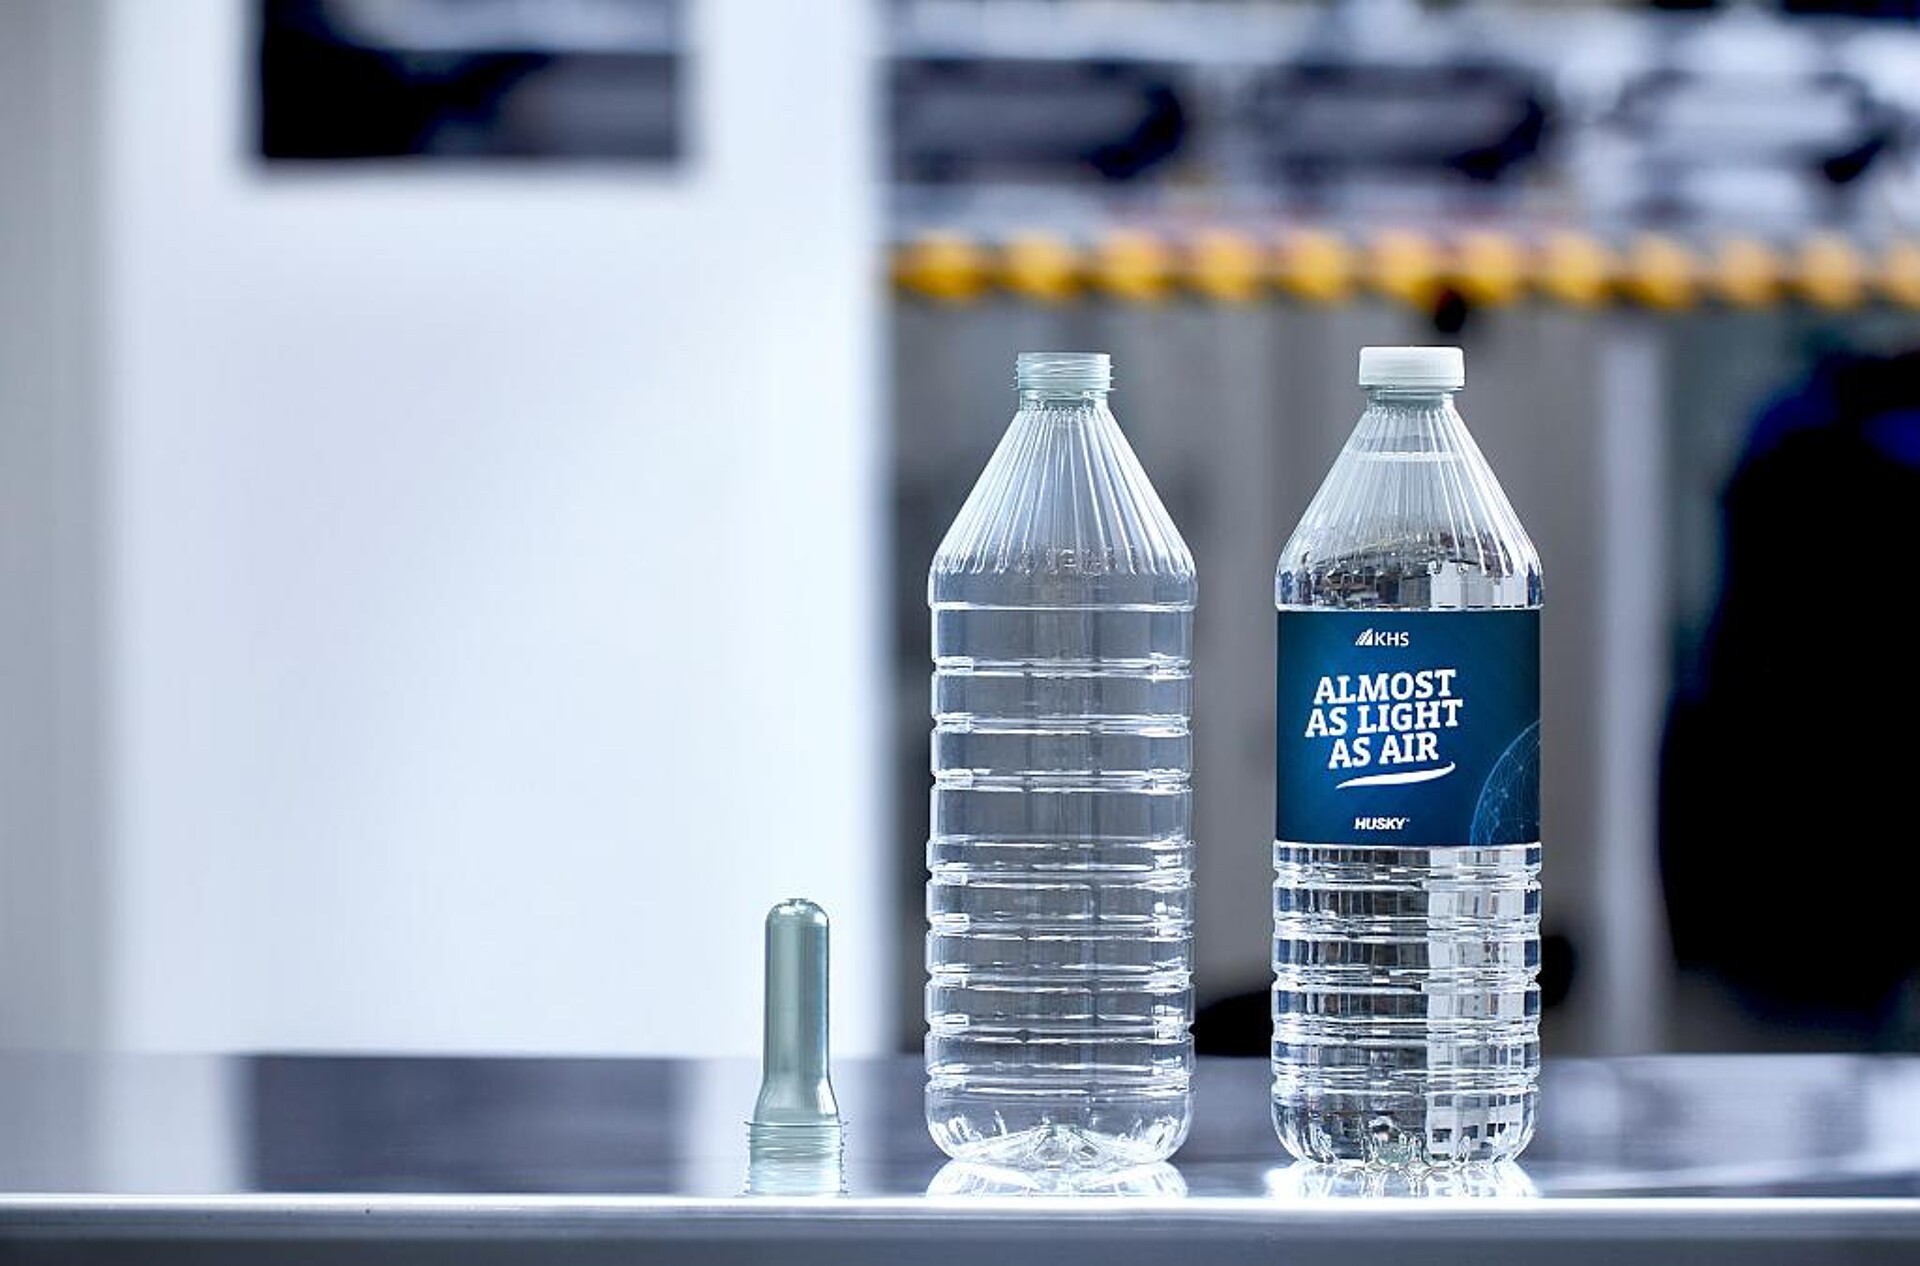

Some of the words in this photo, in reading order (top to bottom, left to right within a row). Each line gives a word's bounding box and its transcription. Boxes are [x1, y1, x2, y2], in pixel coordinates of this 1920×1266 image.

[1374, 632, 1409, 646] KHS
[1313, 669, 1456, 705] ALMOST
[1304, 706, 1348, 738] AS
[1357, 698, 1463, 734] LIGHT
[1328, 736, 1371, 769] AS
[1379, 731, 1439, 765] AIR
